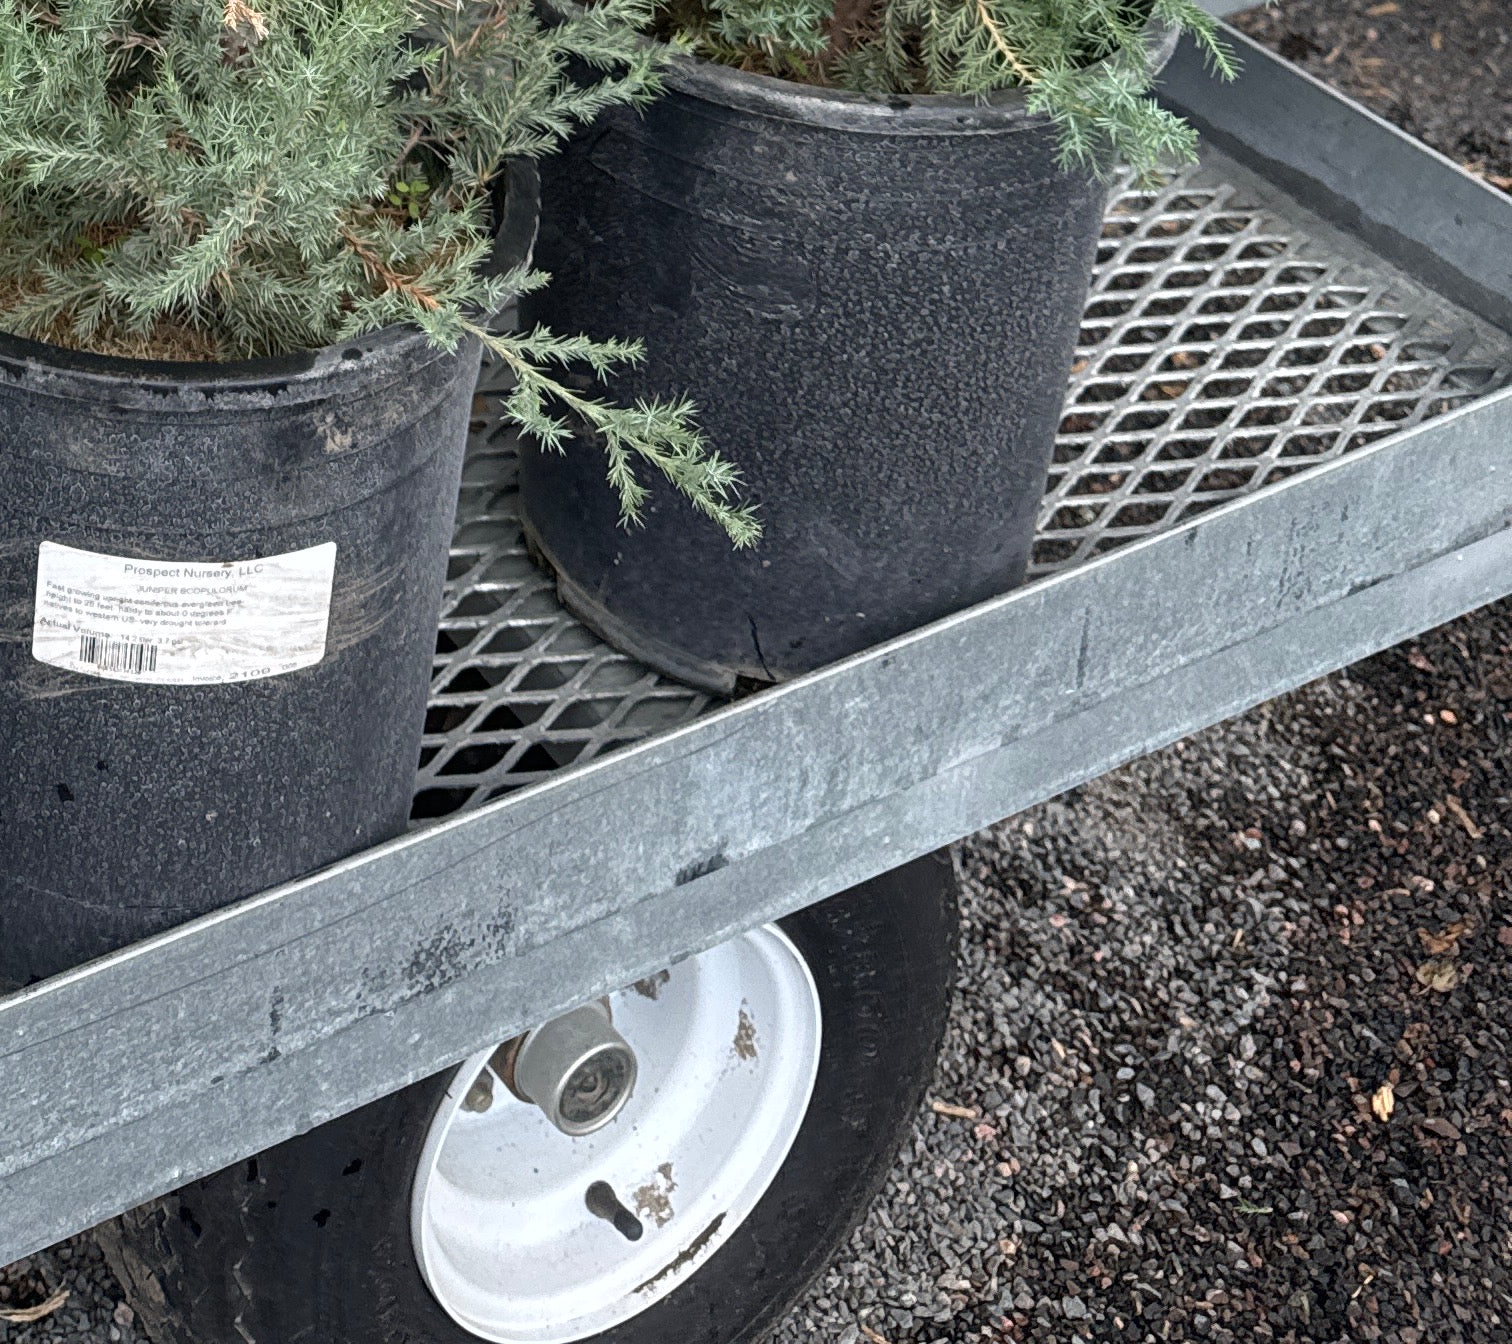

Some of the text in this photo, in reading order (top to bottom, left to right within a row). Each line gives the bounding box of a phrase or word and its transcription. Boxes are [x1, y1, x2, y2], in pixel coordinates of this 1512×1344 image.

[124, 564, 180, 578] Prospect
[239, 564, 264, 577] LLC
[46, 580, 65, 592] Fast
[67, 588, 100, 601] growing
[181, 600, 223, 609] evergreen
[137, 585, 248, 595] JUNIPER SCOPULORUM
[43, 600, 73, 612] natives
[85, 611, 119, 621] western
[160, 619, 193, 628] drought
[46, 591, 72, 603] height
[190, 610, 224, 618] degrees
[40, 617, 71, 630] Actual
